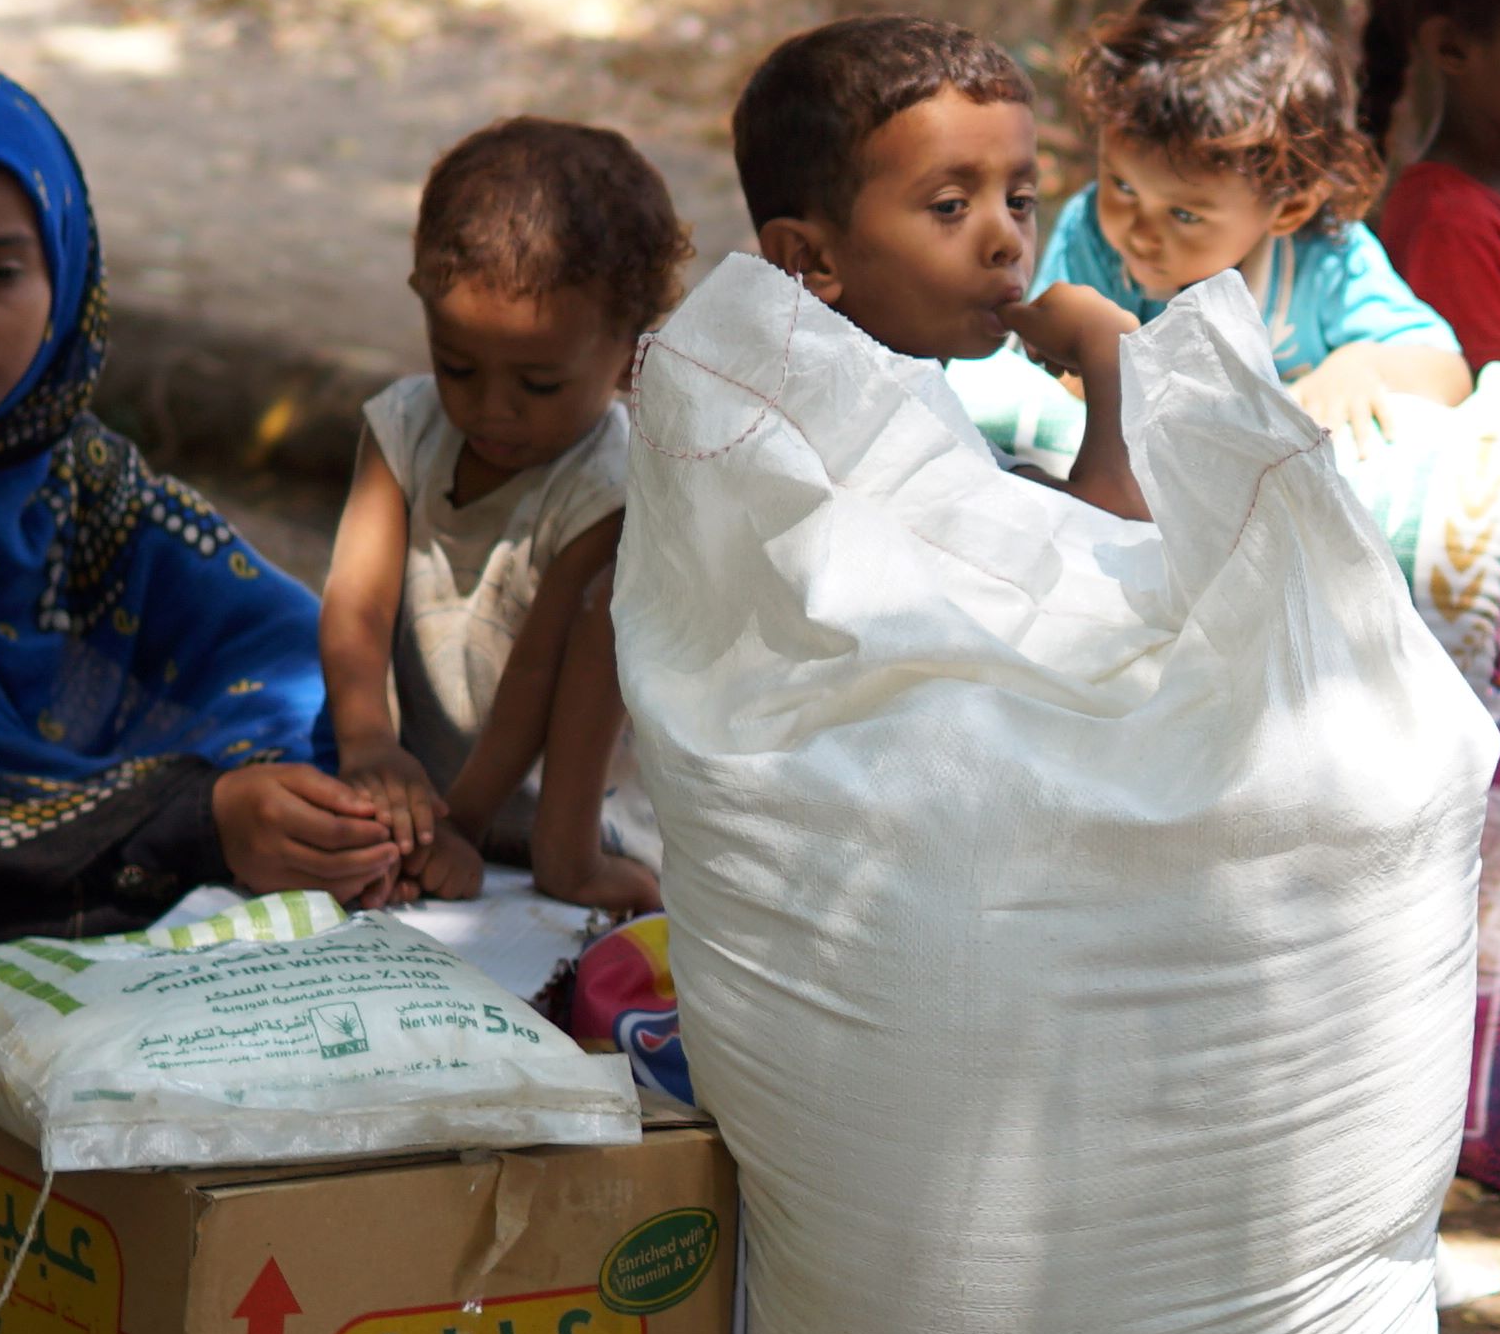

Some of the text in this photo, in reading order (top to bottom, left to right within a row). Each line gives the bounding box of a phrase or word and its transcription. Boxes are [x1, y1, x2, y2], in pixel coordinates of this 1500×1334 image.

[156, 954, 457, 993] PURE FINE WHITE SUGAR
[399, 1016, 427, 1033] Net
[483, 1003, 509, 1035] 5
[511, 1021, 541, 1045] kg
[617, 1224, 706, 1274] Enriched with
[614, 1262, 671, 1295] Vitamin
[674, 1255, 685, 1272] A
